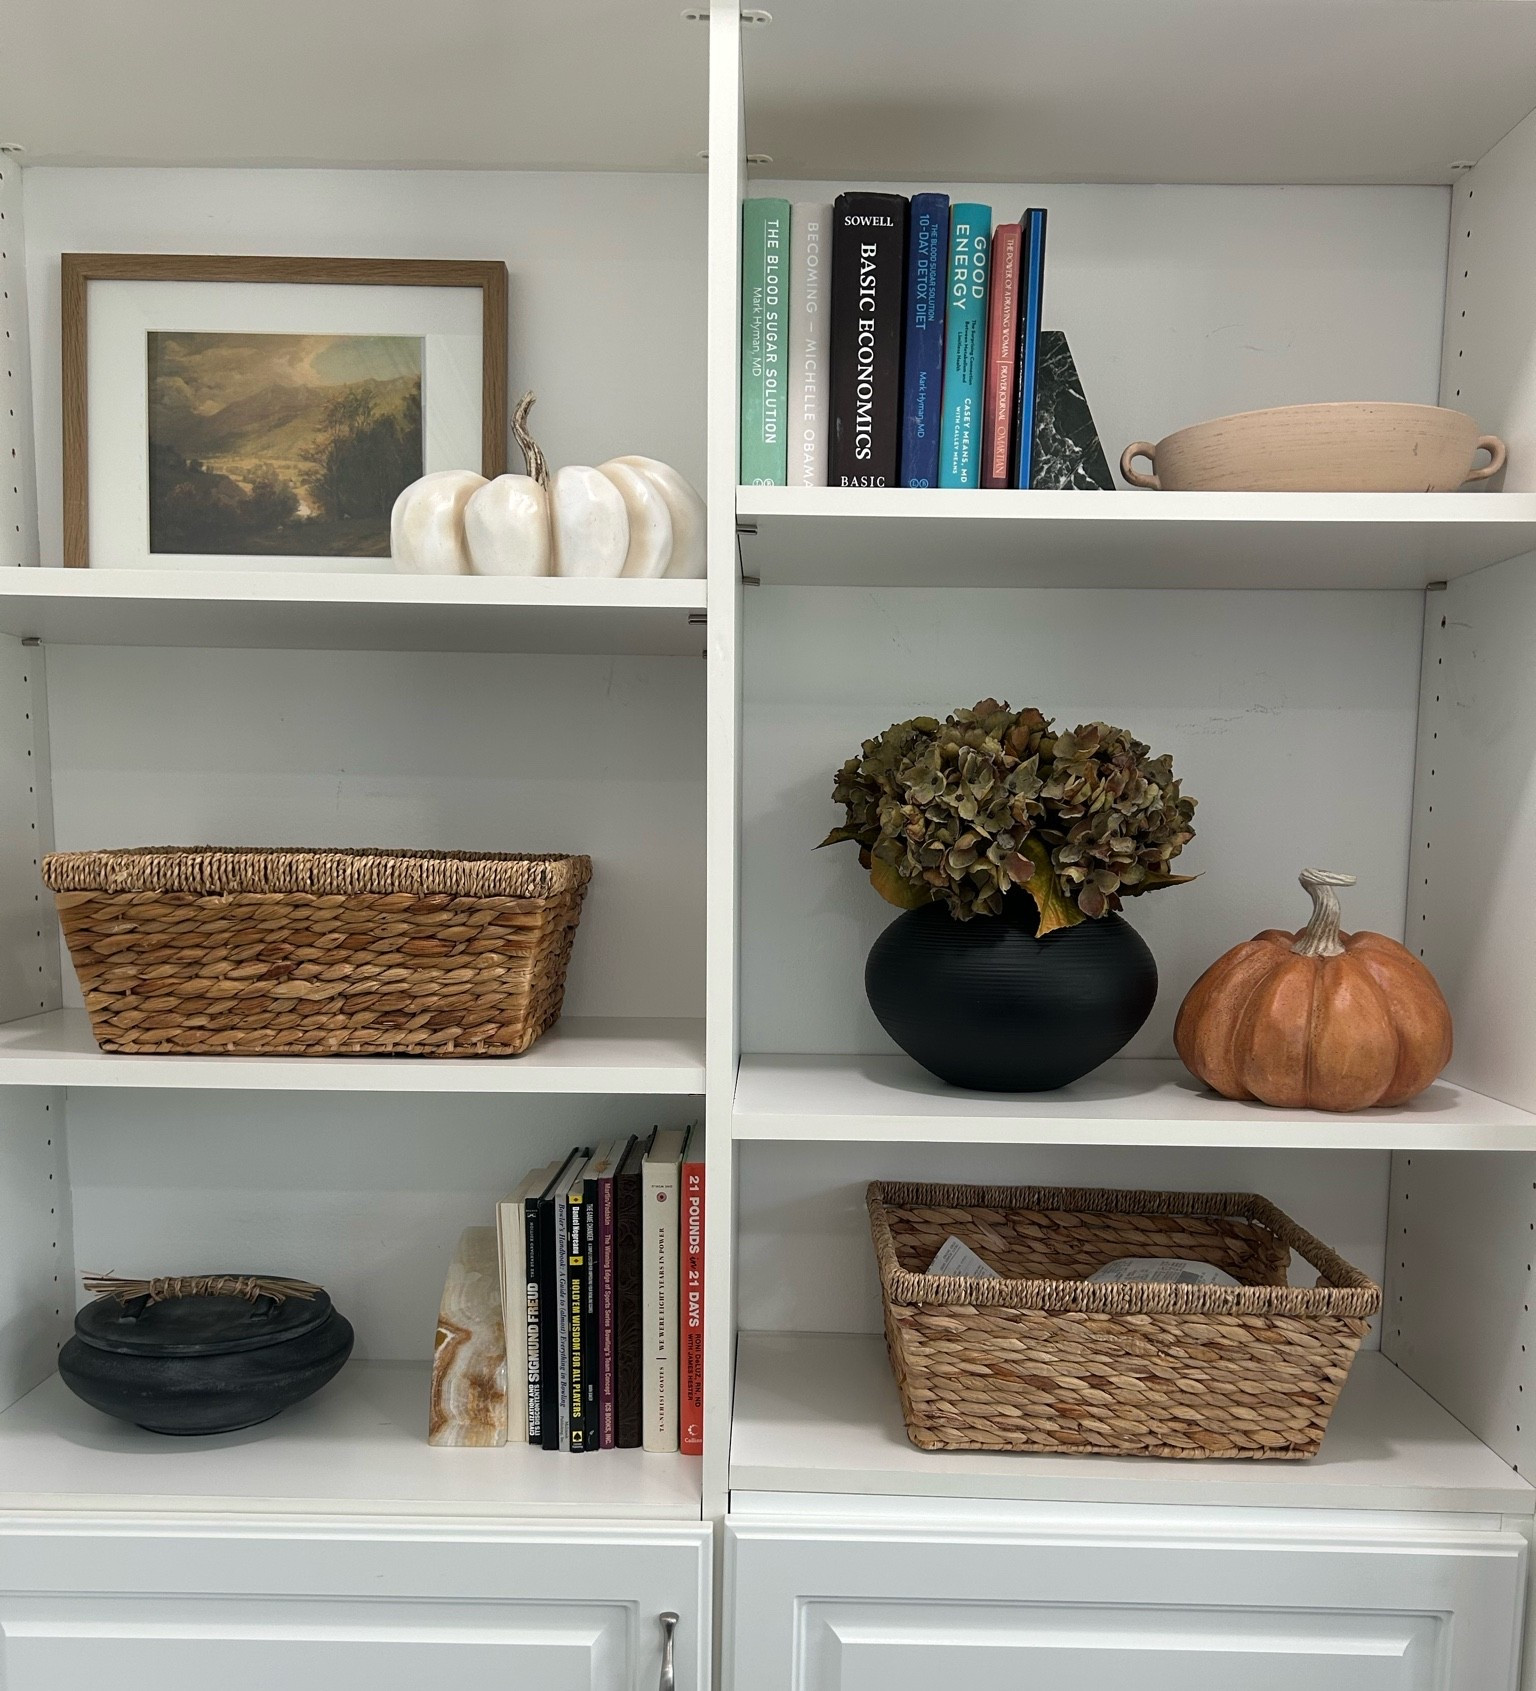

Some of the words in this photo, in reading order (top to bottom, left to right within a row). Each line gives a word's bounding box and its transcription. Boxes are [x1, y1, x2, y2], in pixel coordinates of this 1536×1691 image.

[767, 219, 779, 249] THE
[844, 215, 894, 227] SOWELL
[918, 214, 930, 255] 10-DAY
[930, 239, 938, 261] BLOOD
[1005, 240, 1014, 252] THE
[766, 255, 779, 305] BLOOD
[806, 222, 819, 314] BECOMING
[859, 243, 877, 312] BASIC
[917, 260, 928, 299] DETOX
[929, 263, 937, 286] SUGAR
[953, 225, 970, 310] ENERGY
[971, 236, 986, 299] GOOD
[1004, 253, 1013, 278] POWER
[1004, 280, 1012, 290] OF
[752, 287, 762, 314] Mark
[928, 288, 936, 321] SOLUTION
[1002, 298, 1012, 328] PRAYING
[916, 304, 926, 330] DIET
[750, 316, 762, 354] Hyman,
[766, 312, 778, 363] SUGAR
[1001, 330, 1011, 358] WOMAN
[752, 357, 762, 377] MD
[804, 339, 817, 421] MICHELLE
[919, 371, 927, 391] Mark
[999, 366, 1008, 391] PRAYER
[855, 318, 875, 460] ECONOMICS
[765, 369, 777, 444] SOLUTION
[916, 393, 926, 423] Hyman,
[963, 398, 971, 428] CASEY
[998, 392, 1007, 420] JOURNAL
[917, 424, 925, 438] MD
[961, 431, 970, 465] MEANS,
[996, 427, 1006, 473] OMARTIAN
[841, 476, 885, 487] BASIC
[960, 468, 968, 483] MD
[689, 1175, 700, 1191] 21
[689, 1197, 700, 1254] POUNDS
[660, 1255, 665, 1264] IN
[689, 1256, 699, 1270] in
[689, 1270, 699, 1286] 21
[527, 1282, 539, 1323] FREUD
[689, 1292, 700, 1327] DAYS
[528, 1324, 540, 1382] SIGMUND
[660, 1340, 665, 1351] WE
[573, 1384, 581, 1418] PLAYERS
